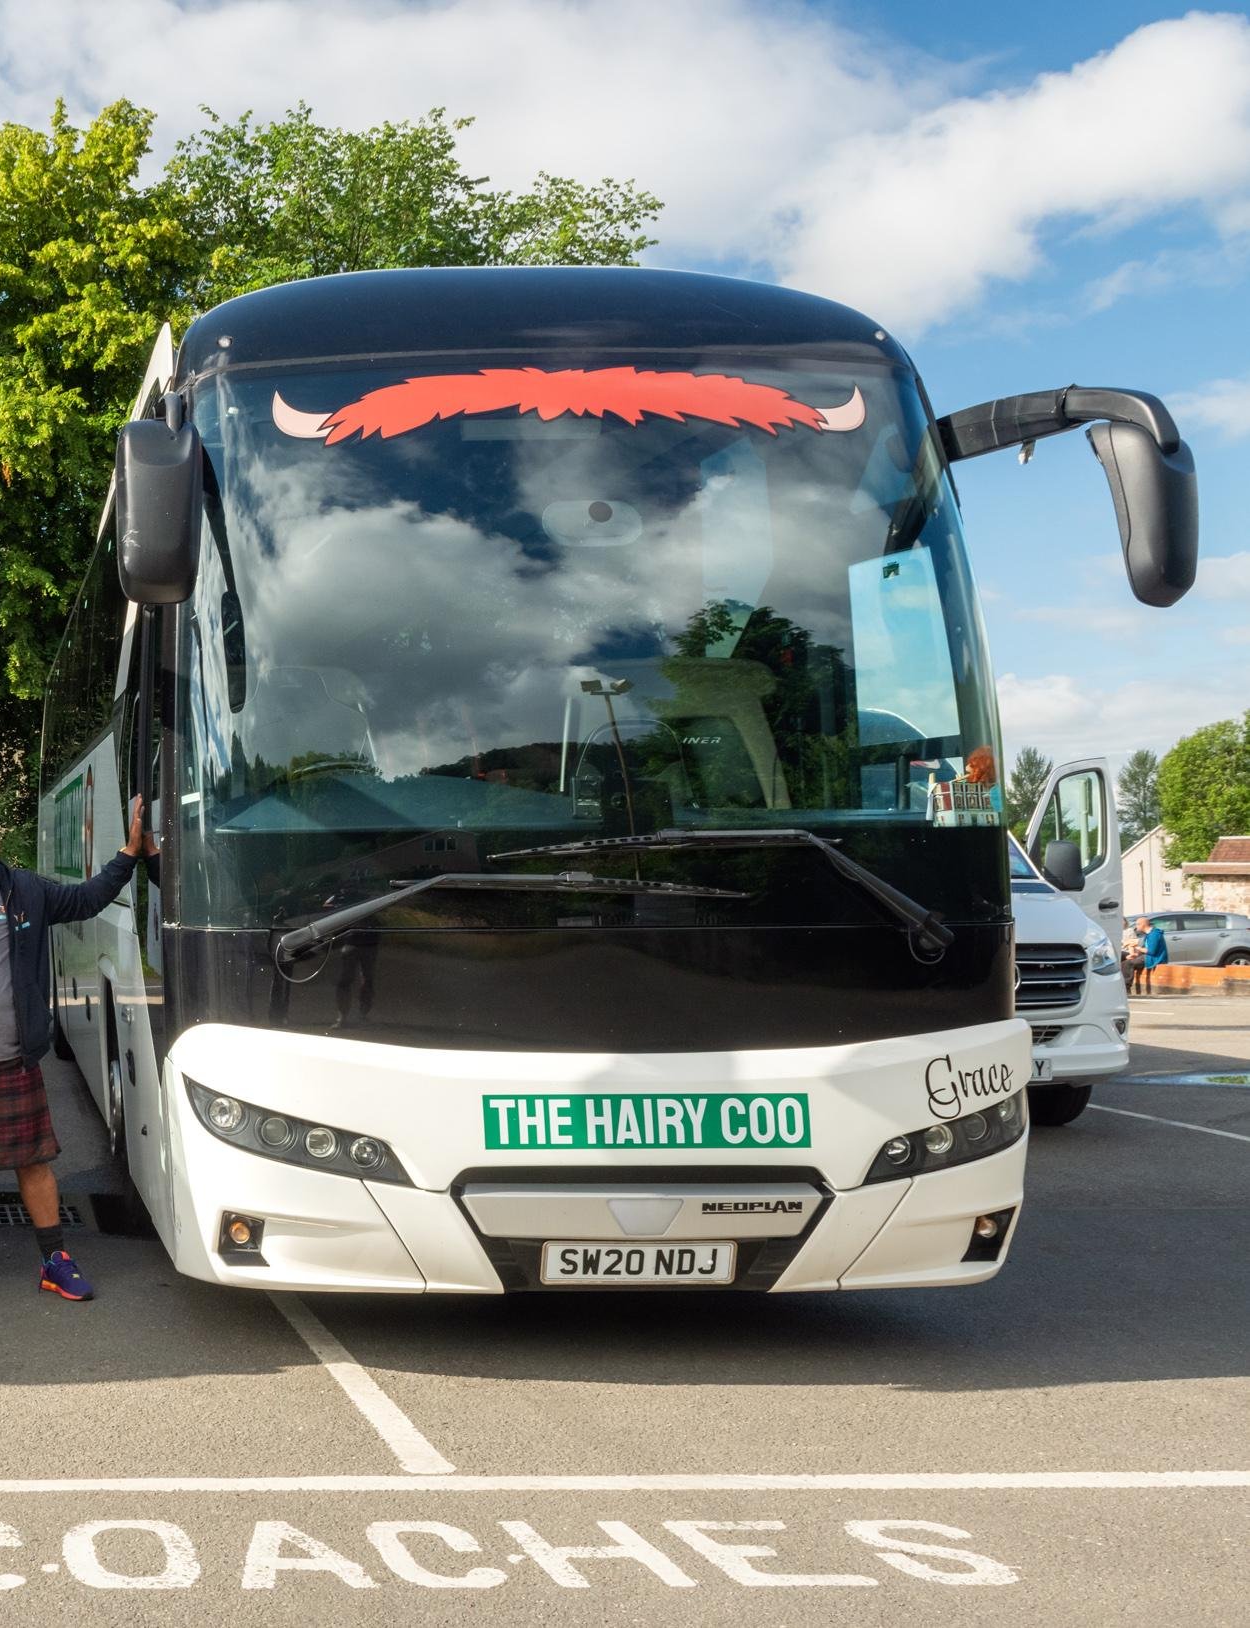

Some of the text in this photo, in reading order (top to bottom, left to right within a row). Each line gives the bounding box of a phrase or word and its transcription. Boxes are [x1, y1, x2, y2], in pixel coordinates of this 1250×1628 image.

[925, 1054, 1013, 1119] Grace
[489, 1097, 804, 1145] THE HAIRY COO
[701, 1201, 802, 1214] NEOPLAN
[560, 1248, 717, 1275] SW20 NDJ
